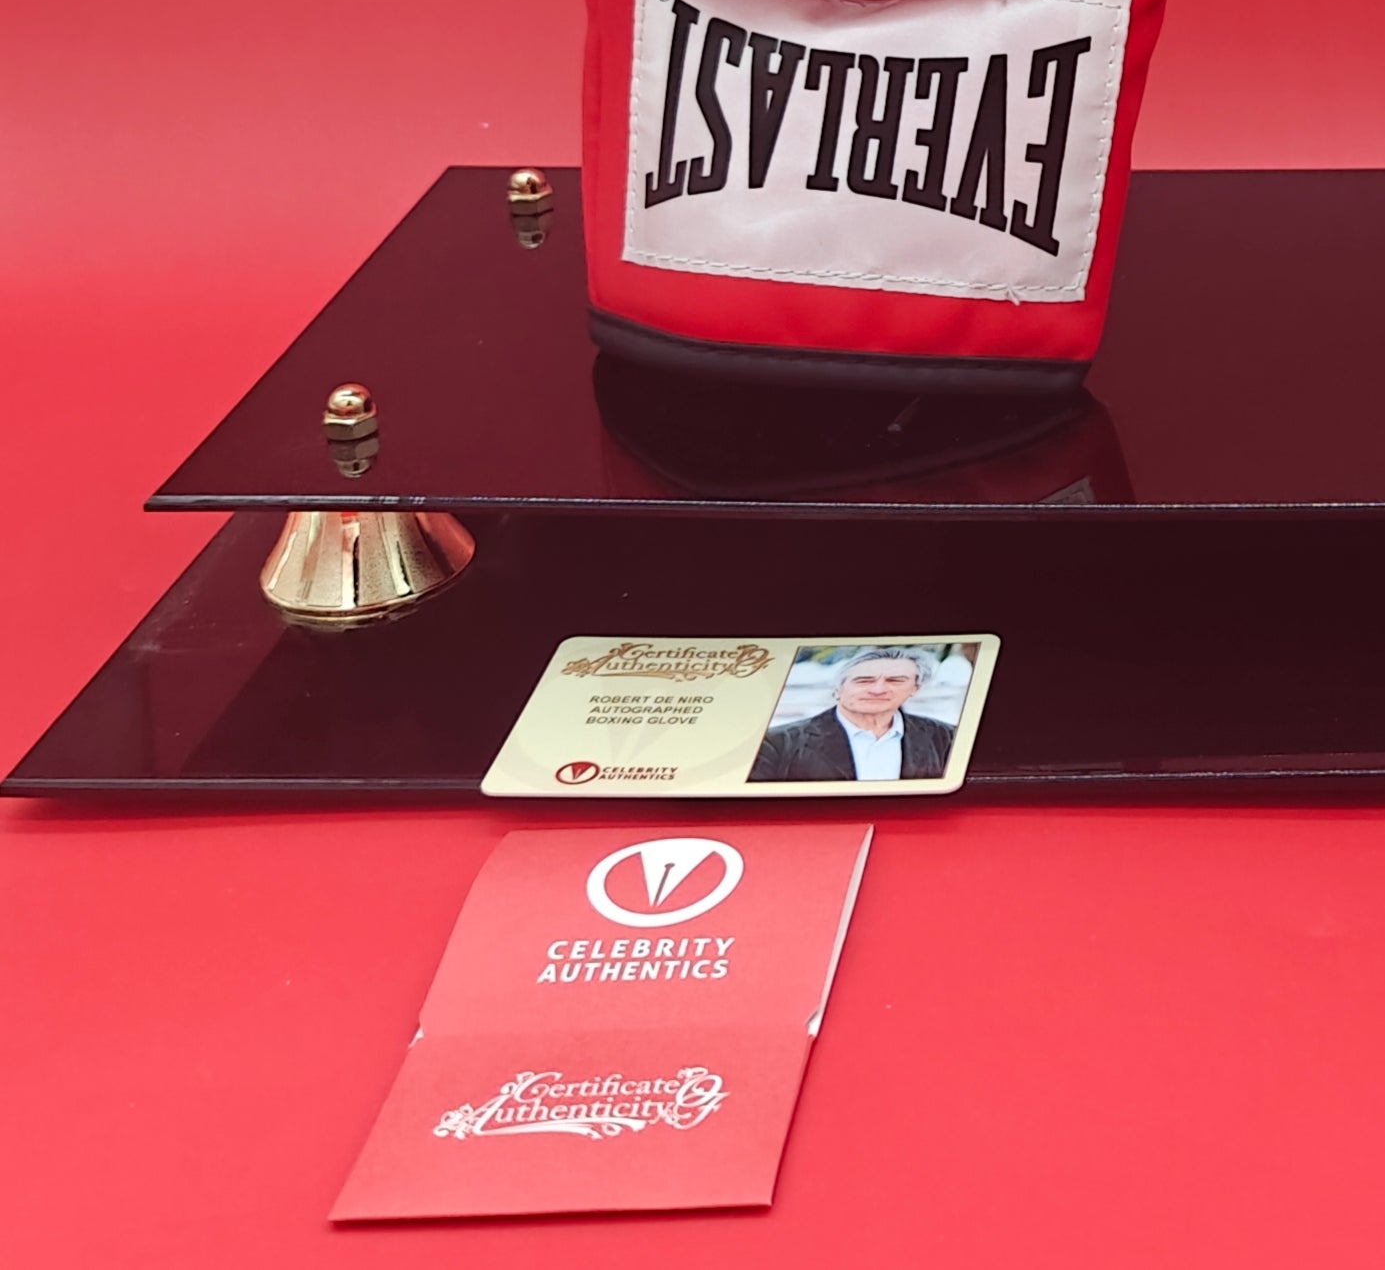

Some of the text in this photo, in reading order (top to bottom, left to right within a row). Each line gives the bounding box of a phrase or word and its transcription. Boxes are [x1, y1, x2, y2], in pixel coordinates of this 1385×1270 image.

[609, 643, 739, 661] Certificate
[561, 654, 736, 681] Authenticity
[589, 695, 715, 704] ROBERT DE NIRO
[589, 706, 704, 714] AUTOGRAPHED
[585, 716, 699, 725] BOXING GLOVE
[602, 766, 679, 774] CELEBRITY
[546, 936, 735, 961] CELEBRITY
[537, 959, 729, 984] AUTHENTICS
[500, 1071, 680, 1103] Certificate
[433, 1093, 675, 1138] Authenticity
